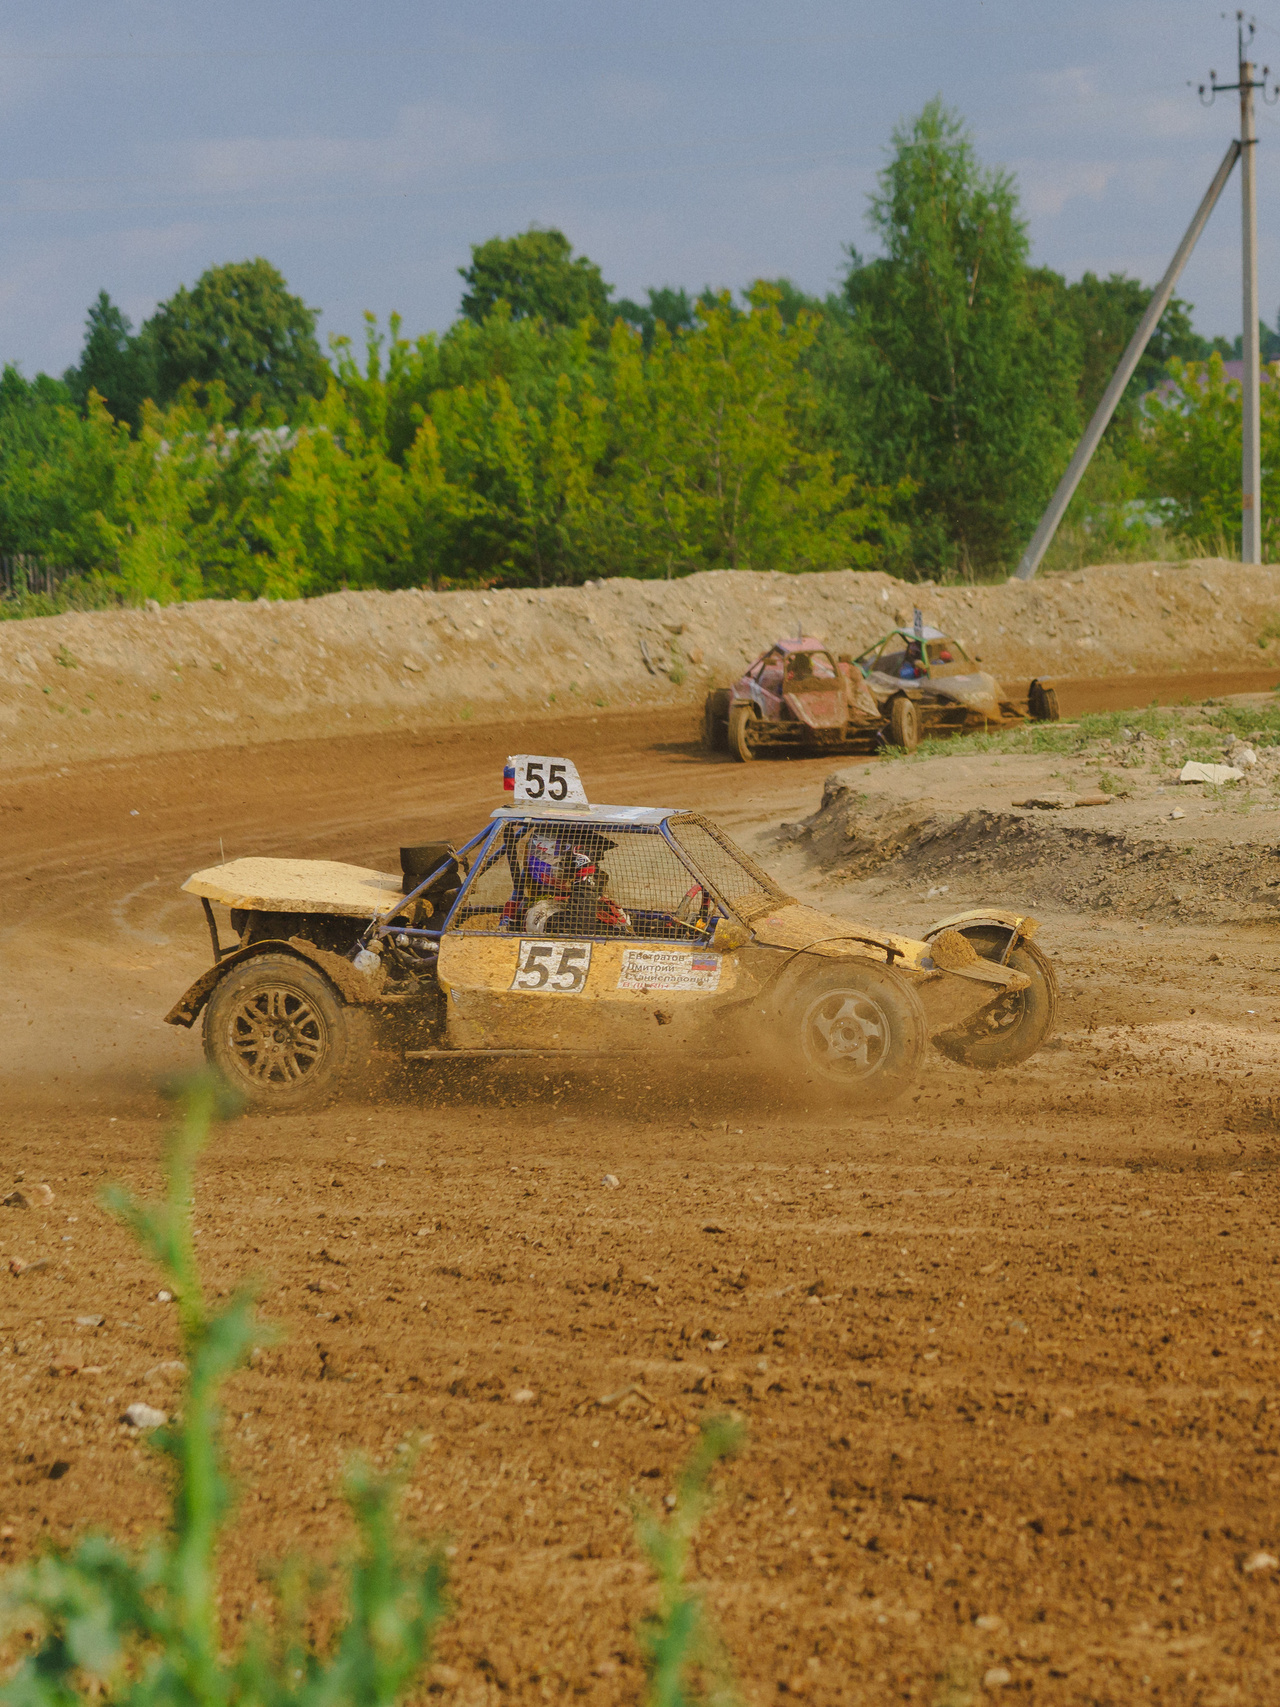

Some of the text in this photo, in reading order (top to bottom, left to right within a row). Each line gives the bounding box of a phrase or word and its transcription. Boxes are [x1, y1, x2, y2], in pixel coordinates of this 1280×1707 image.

[525, 762, 568, 801] 55
[628, 951, 685, 962] Евстратов
[518, 946, 586, 991] 55
[628, 962, 675, 973] Дмитрий
[625, 972, 710, 983] Станиславович
